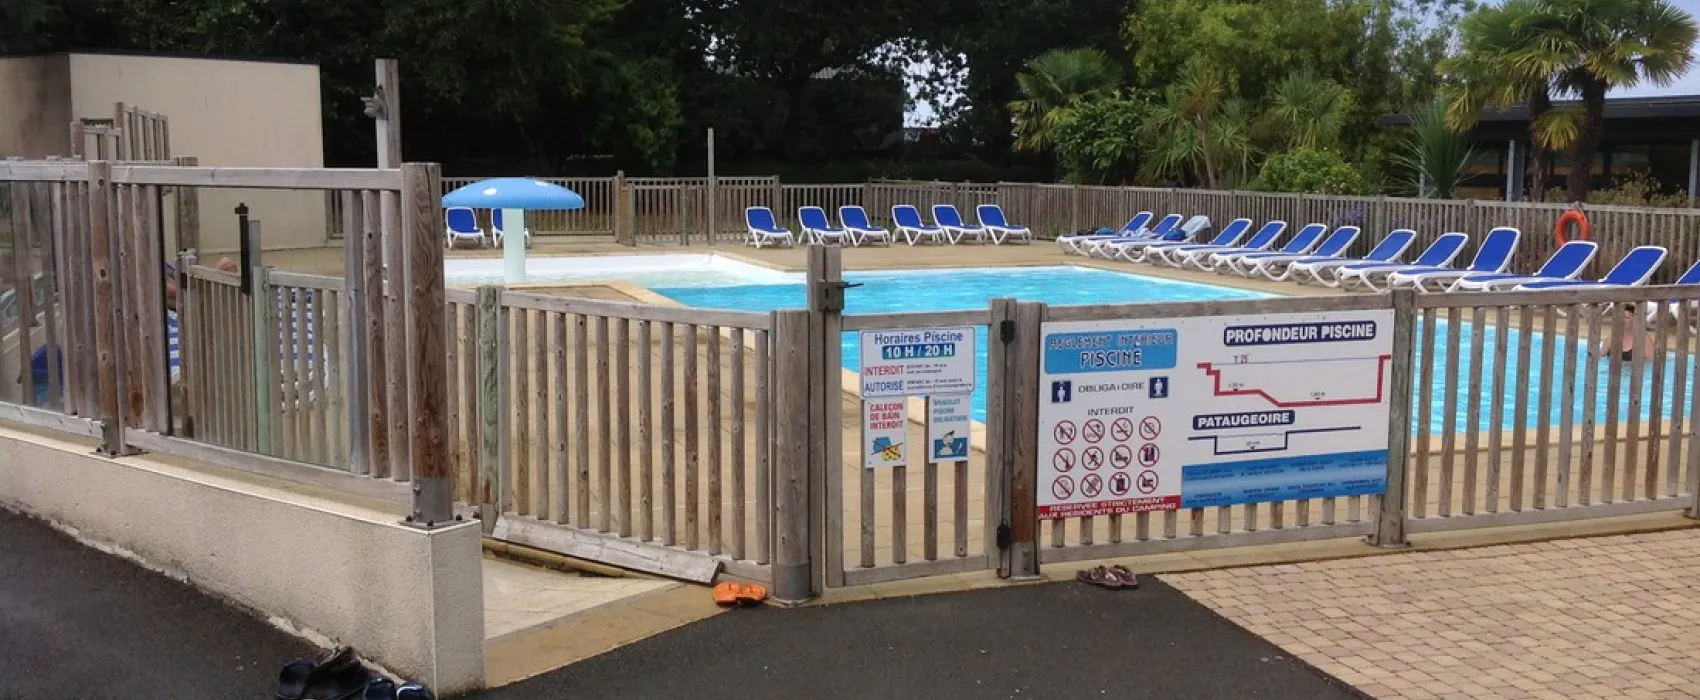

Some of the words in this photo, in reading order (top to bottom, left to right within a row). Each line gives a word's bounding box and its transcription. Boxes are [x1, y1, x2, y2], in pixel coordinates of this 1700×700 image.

[874, 333, 920, 345] Horaires
[923, 331, 963, 342] Piscine
[1226, 327, 1318, 343] PROFONDEUR
[1321, 323, 1374, 339] PISCINE
[886, 346, 900, 358] 10
[905, 346, 914, 357] H
[925, 345, 939, 356] 20
[943, 344, 953, 355] H
[1080, 349, 1143, 368] PISCINE
[865, 365, 905, 376] INTERDIT
[1078, 381, 1145, 393] OBLIGATOIRE
[869, 413, 879, 421] DE
[1087, 406, 1134, 416] INTERDIT
[869, 420, 903, 430] INTERDIT
[1197, 412, 1290, 428] PATAUGEOIRE
[1116, 506, 1130, 514] DU
[1132, 502, 1178, 512] CAMPING
